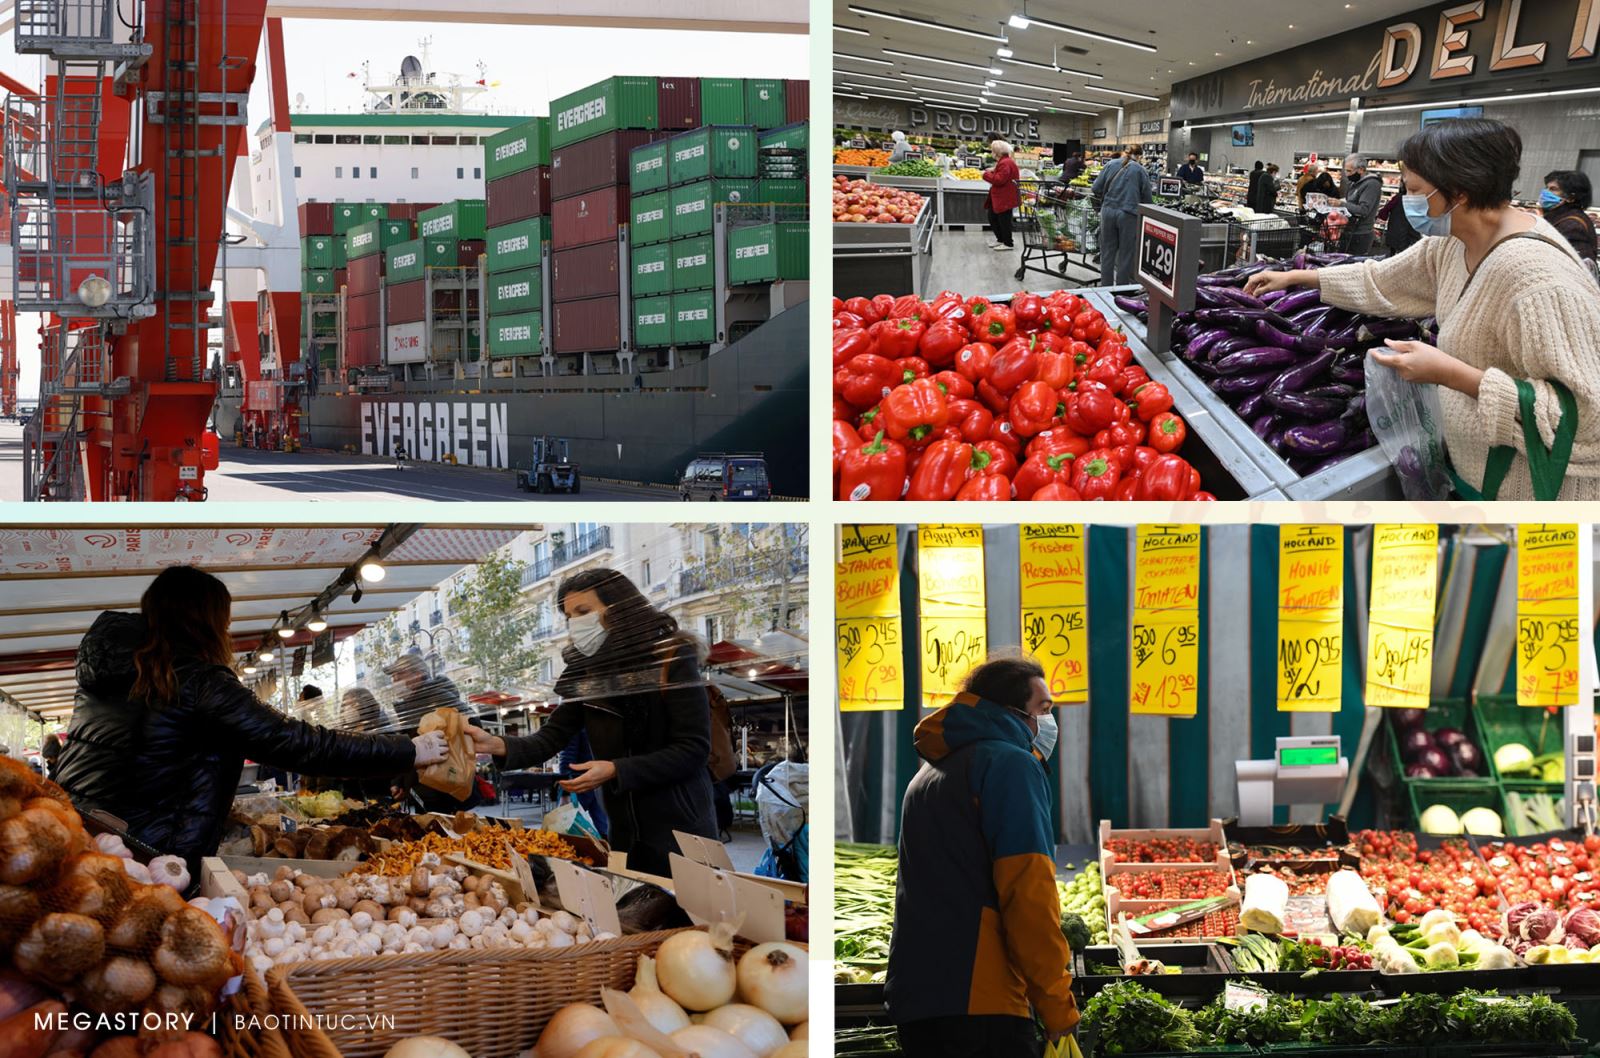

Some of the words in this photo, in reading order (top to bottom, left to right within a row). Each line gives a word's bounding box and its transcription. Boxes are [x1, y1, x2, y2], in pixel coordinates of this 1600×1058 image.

[1242, 50, 1381, 110] International
[1376, 0, 1600, 89] DELI
[557, 96, 607, 132] EVERGREEN
[910, 107, 1040, 139] PRODUCE
[495, 137, 527, 161] EVERGREEN
[1162, 184, 1178, 192] 1.29
[1145, 239, 1173, 276] 1.29
[361, 402, 509, 469] EVERGREEN
[126, 528, 141, 552] PARIS
[1023, 524, 1075, 537] Belgien
[1022, 555, 1083, 579] Rosenkohl
[1288, 559, 1331, 579] HONIG
[837, 575, 895, 602] BOHNEN
[1281, 584, 1339, 613] TOMATEN
[838, 622, 861, 651] 500
[1024, 612, 1045, 641] 500
[1133, 624, 1156, 649] 500
[1519, 617, 1544, 644] 500
[926, 625, 953, 674] 500
